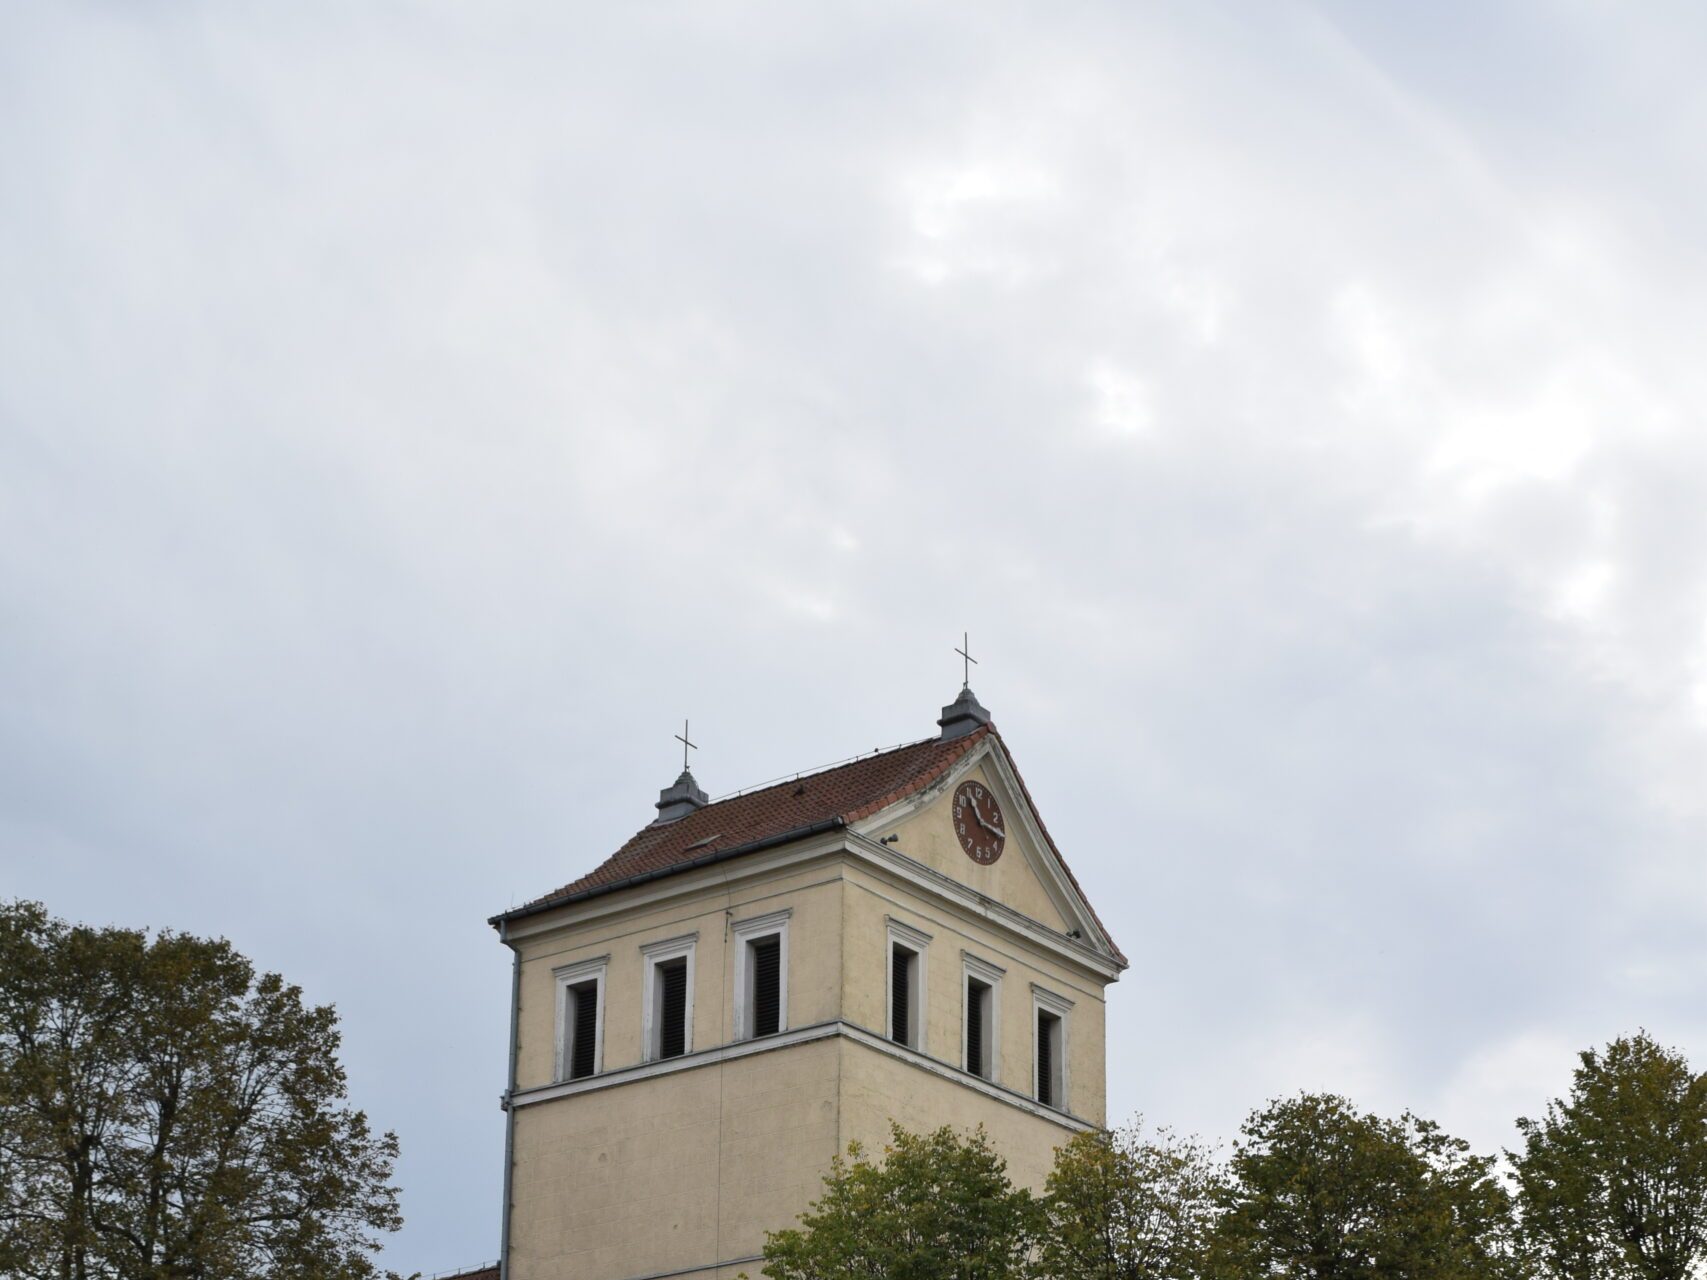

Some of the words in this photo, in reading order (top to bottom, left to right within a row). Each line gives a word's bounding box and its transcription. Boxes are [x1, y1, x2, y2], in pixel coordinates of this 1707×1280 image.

[975, 787, 983, 799] 12
[959, 794, 967, 807] 10
[956, 807, 962, 819] 9
[993, 812, 998, 823] 2
[960, 823, 966, 835] 8
[967, 838, 973, 849] 7
[992, 840, 998, 851] 4
[976, 846, 982, 858] 6
[985, 847, 990, 858] 5
